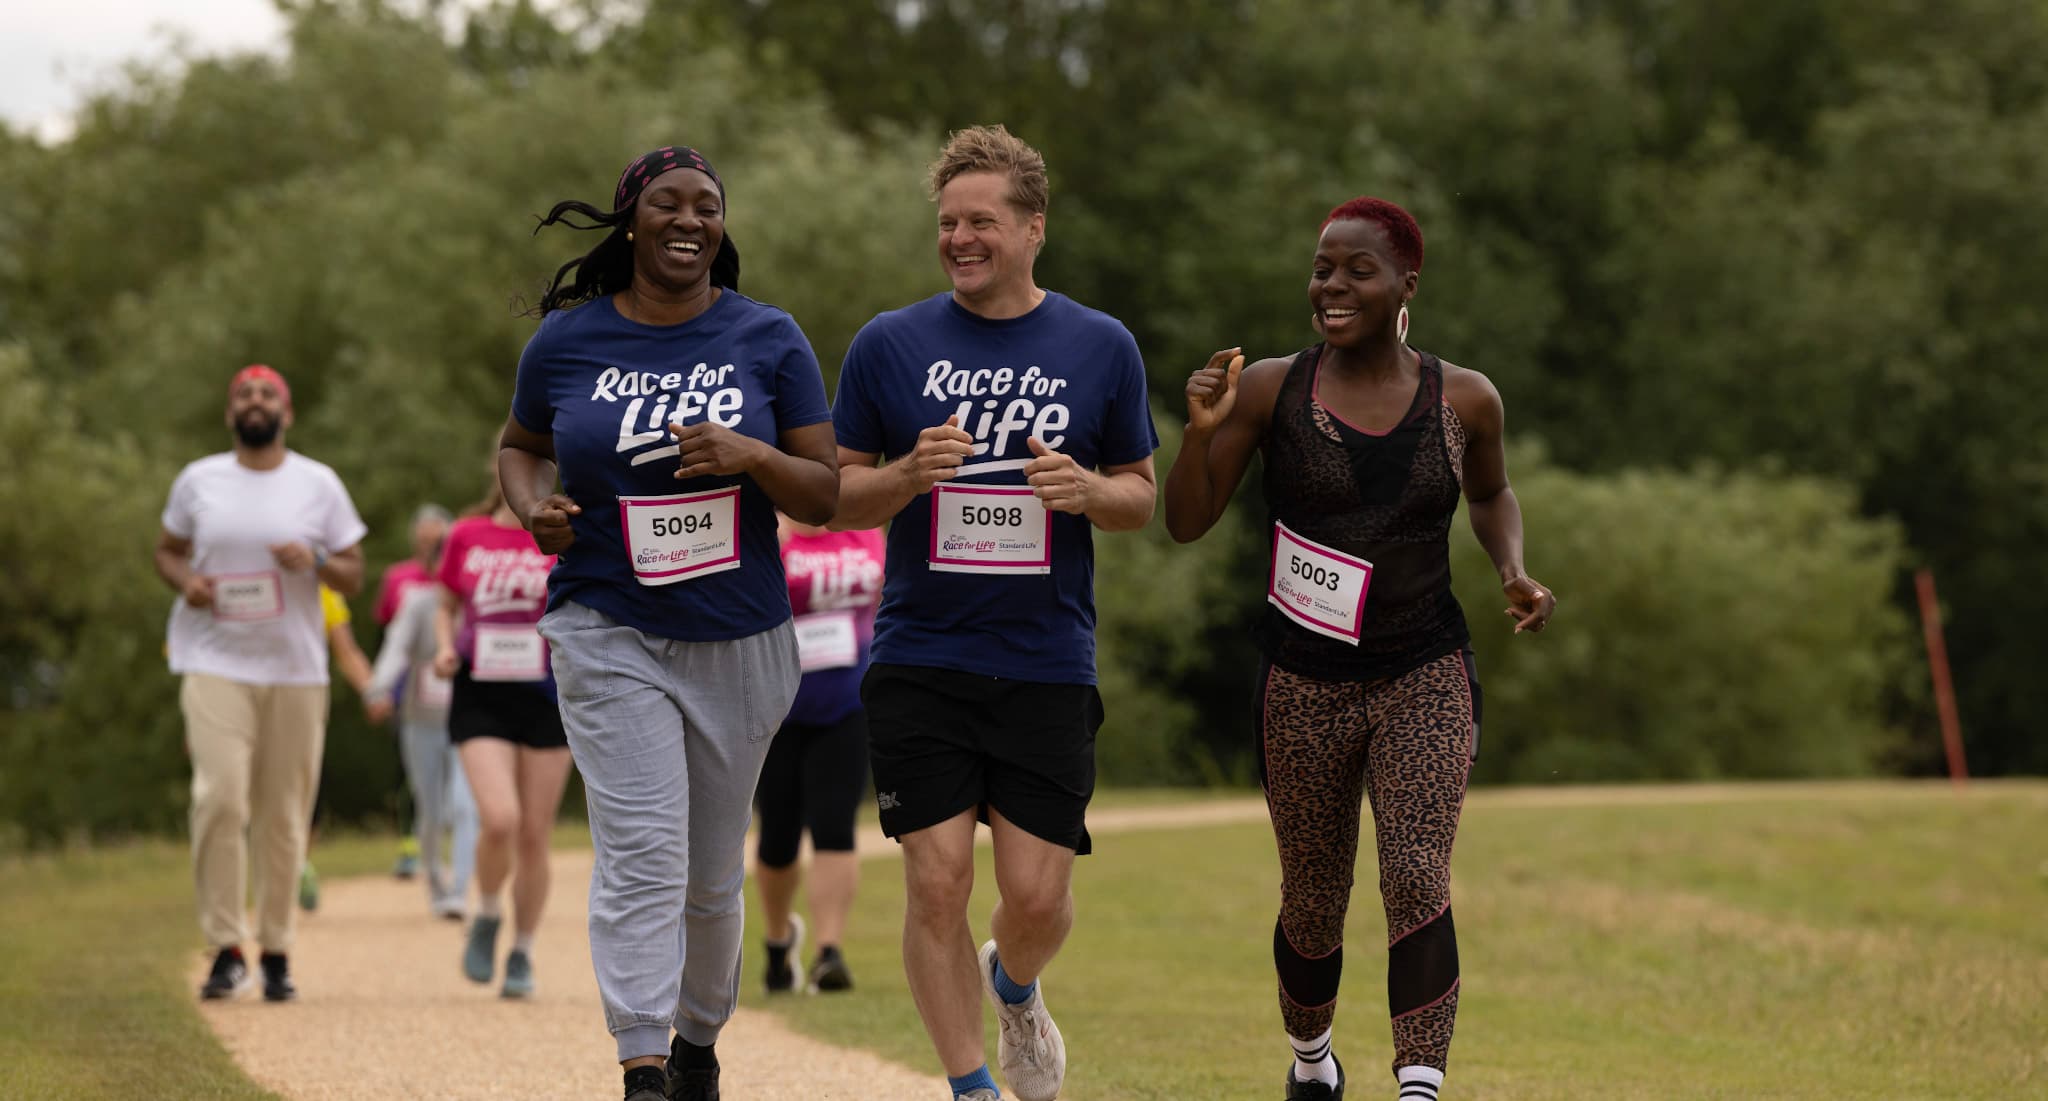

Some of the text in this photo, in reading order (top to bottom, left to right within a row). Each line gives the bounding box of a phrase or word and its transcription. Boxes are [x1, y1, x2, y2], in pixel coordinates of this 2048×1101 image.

[591, 362, 735, 402] Race for
[922, 359, 1067, 402] Race for
[616, 387, 743, 453] Life
[956, 399, 1070, 457] Life
[652, 511, 712, 537] 5094
[962, 506, 1022, 527] 5098
[637, 555, 657, 566] Race
[658, 553, 670, 562] for
[670, 548, 689, 561] Life
[943, 540, 996, 551] Race for Life
[1290, 555, 1340, 591] 5003
[1297, 591, 1312, 605] Life
[1314, 601, 1337, 614] Standard
